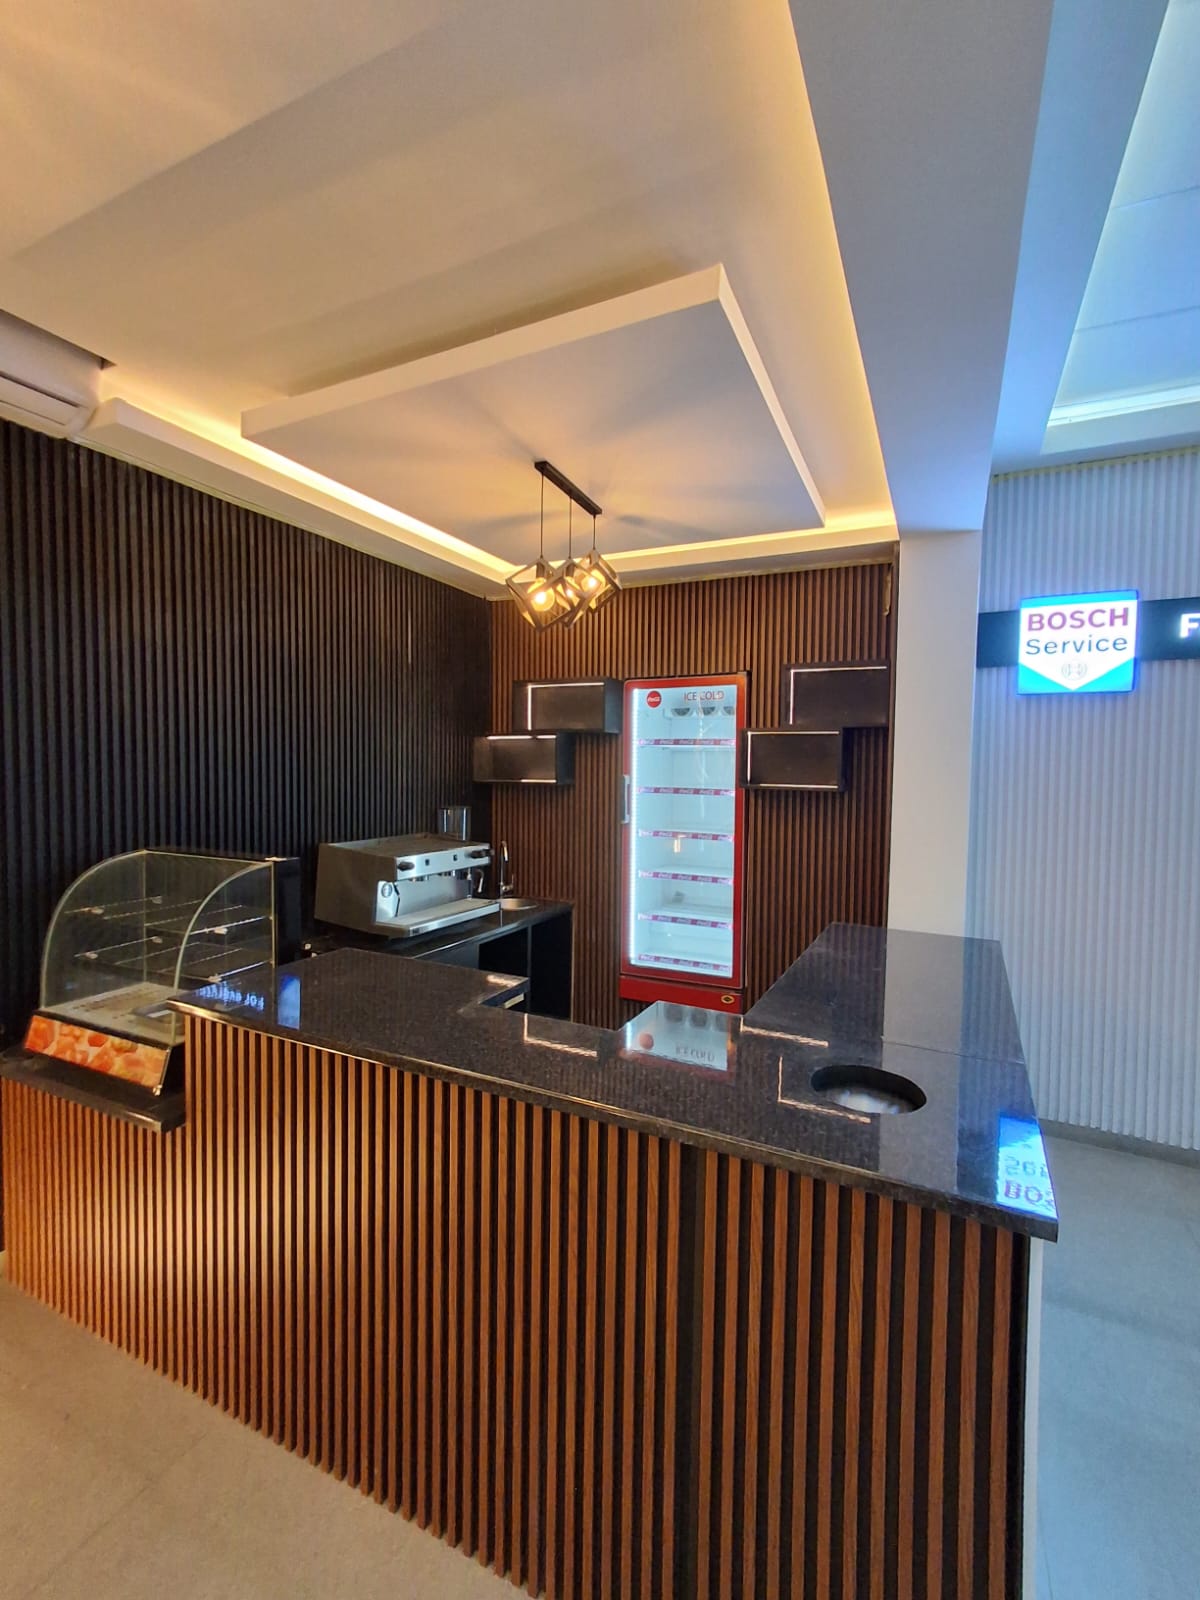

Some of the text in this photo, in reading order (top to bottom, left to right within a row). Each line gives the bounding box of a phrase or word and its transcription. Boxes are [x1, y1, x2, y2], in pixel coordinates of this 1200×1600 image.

[1027, 607, 1129, 632] BOSCH
[1025, 634, 1128, 656] Service
[684, 690, 725, 701] ICE COLD
